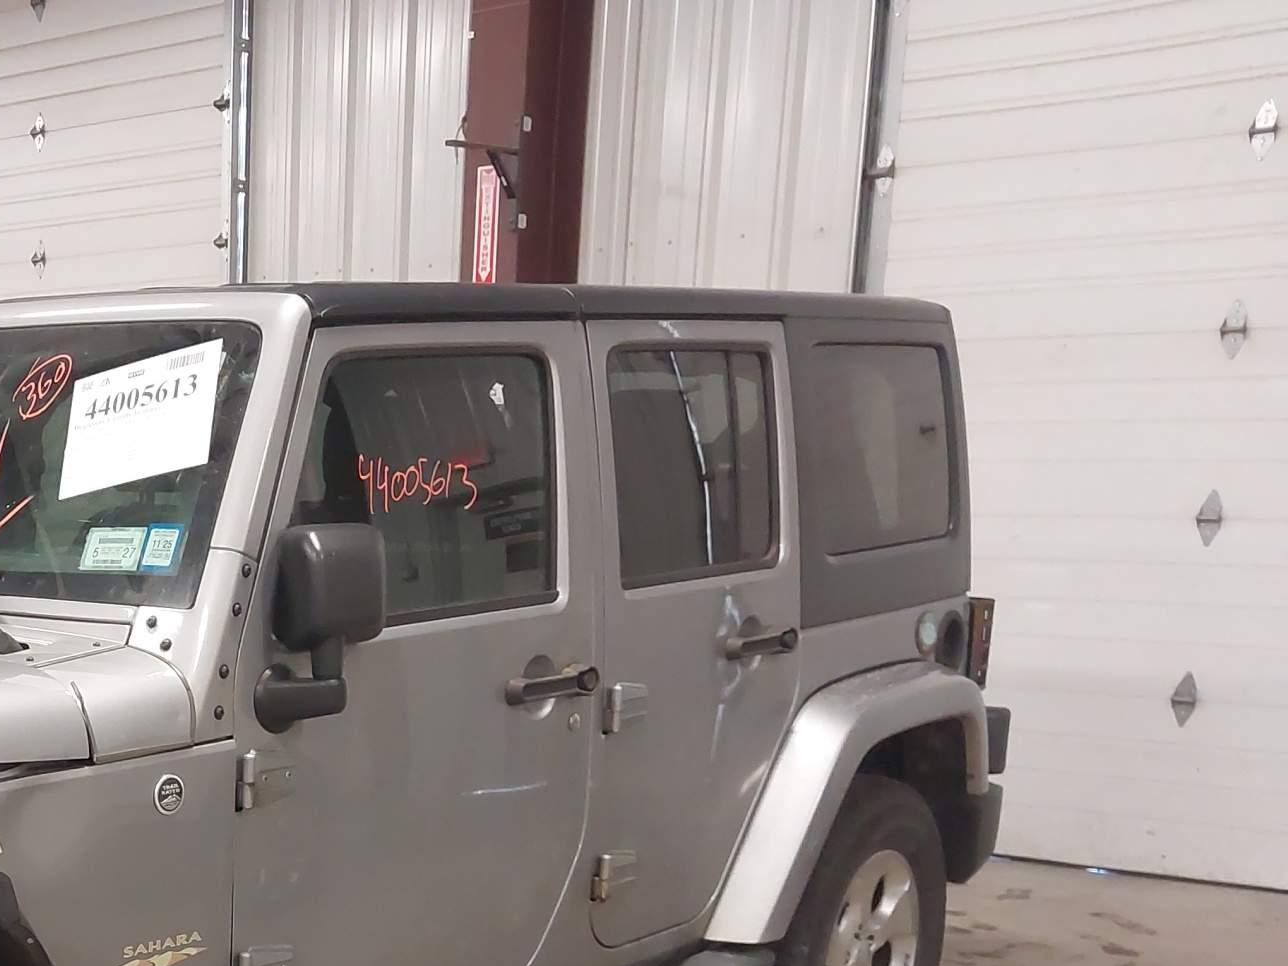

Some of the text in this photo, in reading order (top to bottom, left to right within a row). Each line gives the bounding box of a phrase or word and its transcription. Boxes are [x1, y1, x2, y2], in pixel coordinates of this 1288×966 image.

[19, 358, 68, 419] 360
[84, 373, 198, 420] 44005613
[357, 453, 478, 515] 44005613
[122, 547, 136, 558] 27
[123, 931, 202, 958] SAHARA
